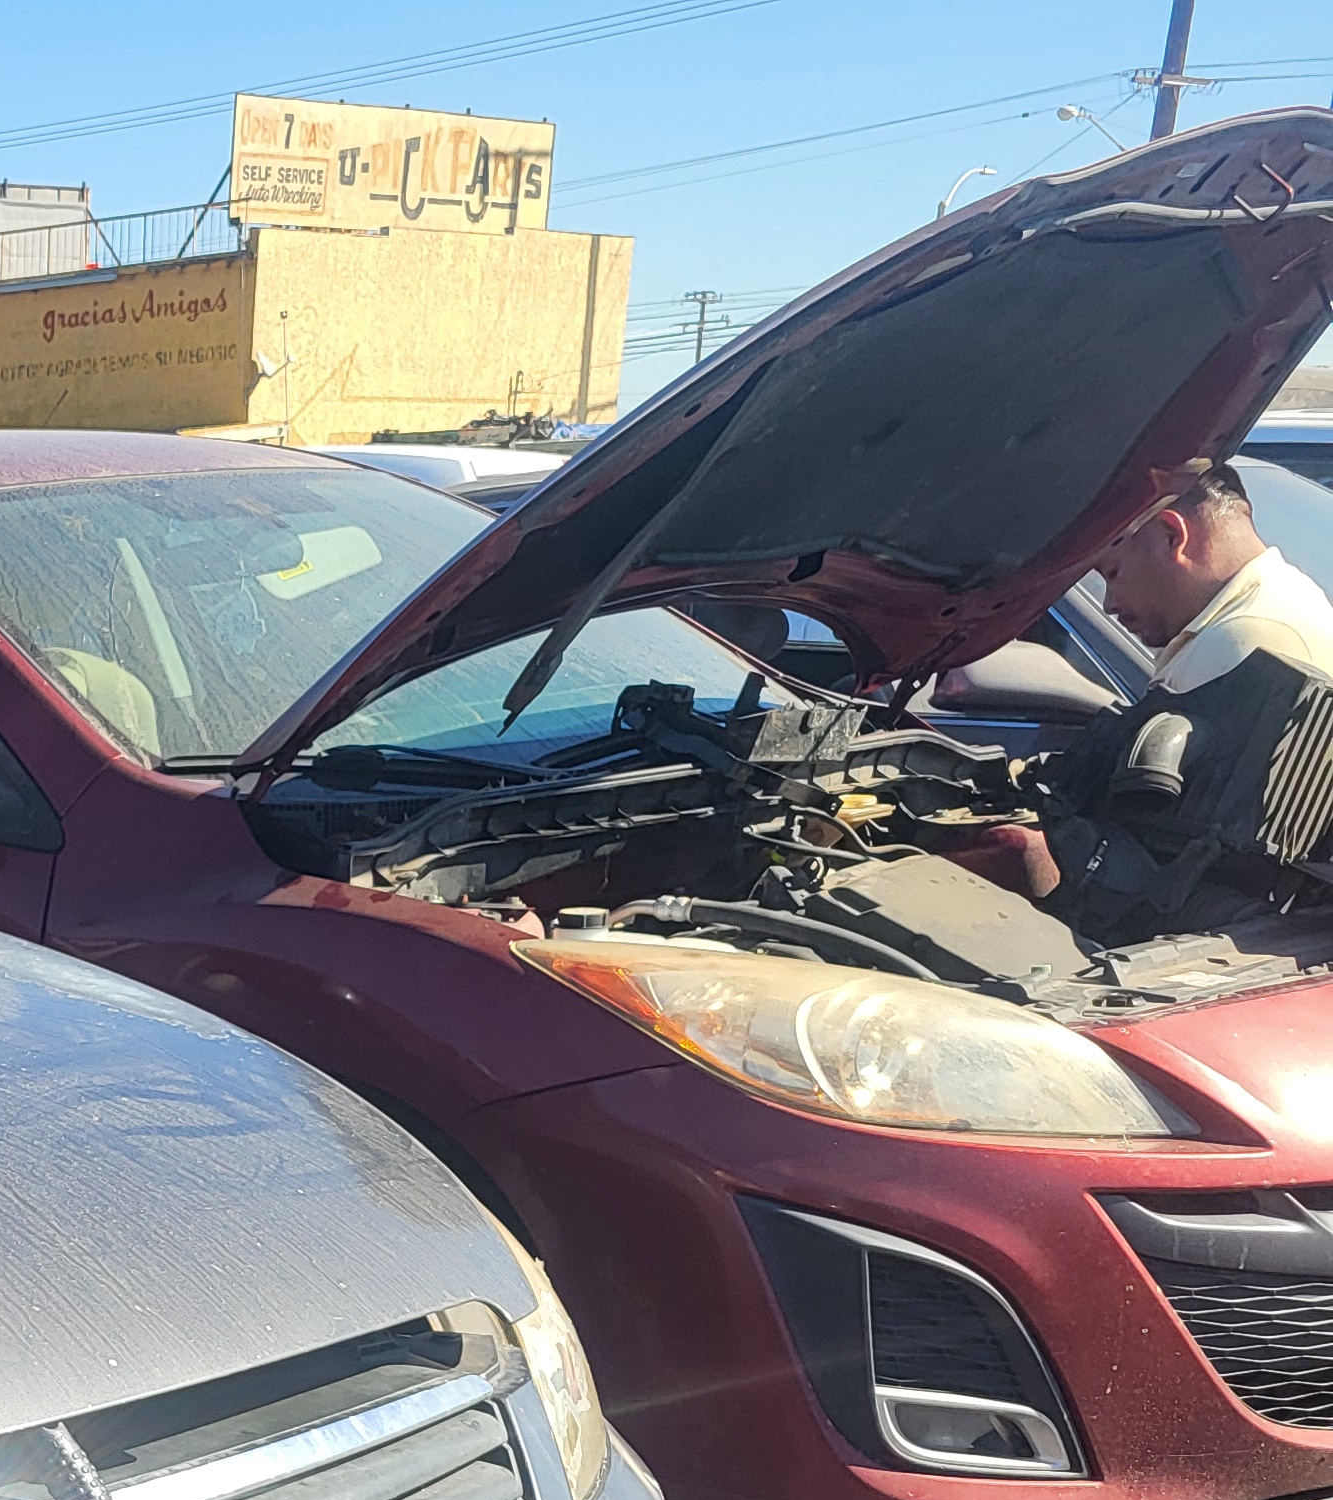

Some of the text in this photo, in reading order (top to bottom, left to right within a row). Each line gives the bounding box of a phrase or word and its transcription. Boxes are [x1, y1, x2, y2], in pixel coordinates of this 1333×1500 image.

[284, 113, 295, 149] 7
[298, 120, 334, 150] DAYS
[241, 164, 324, 186] SELF SERVICE
[269, 184, 323, 212] Wrecking
[131, 287, 228, 323] Amigos
